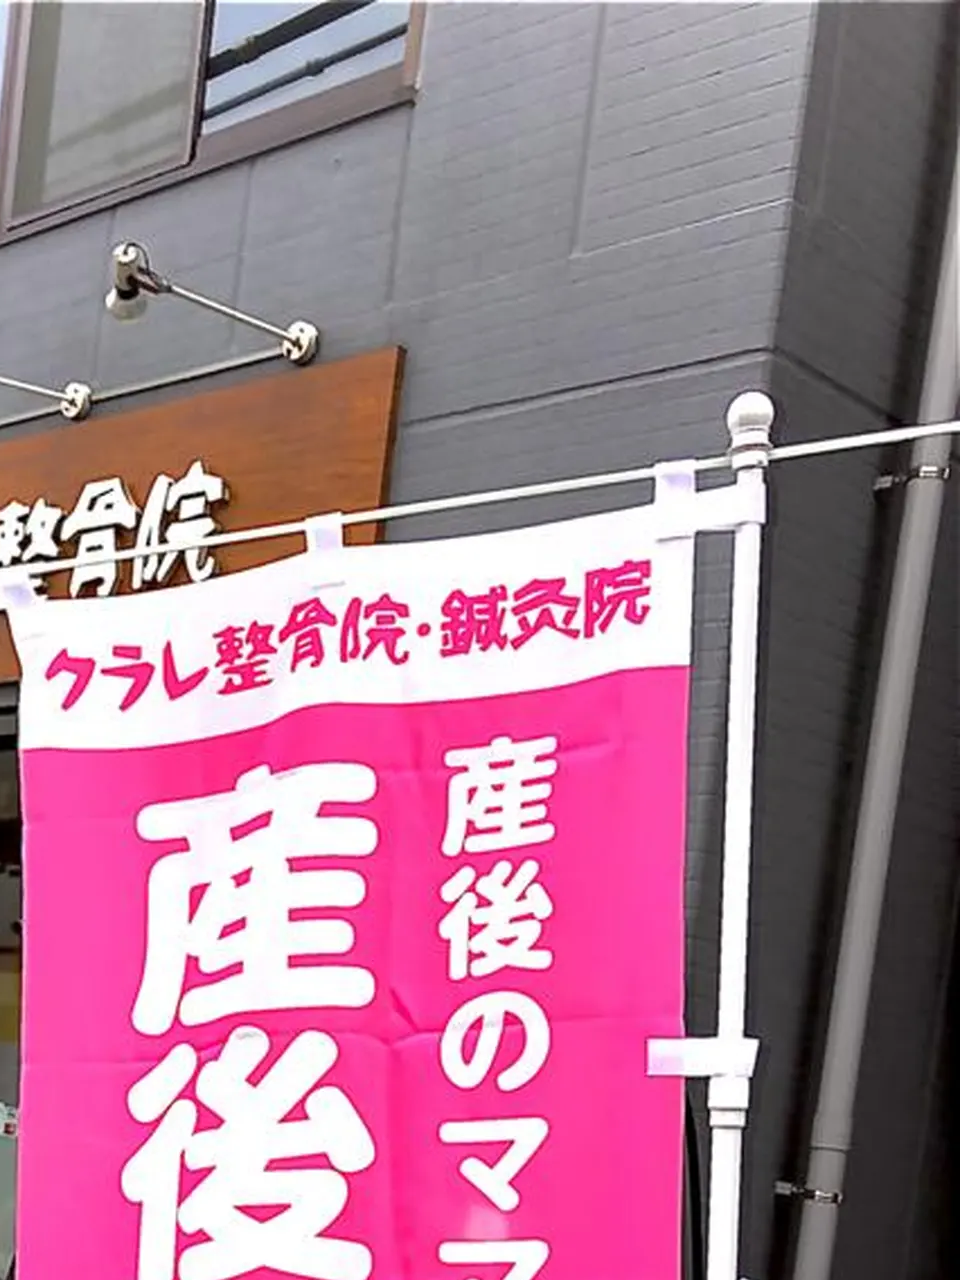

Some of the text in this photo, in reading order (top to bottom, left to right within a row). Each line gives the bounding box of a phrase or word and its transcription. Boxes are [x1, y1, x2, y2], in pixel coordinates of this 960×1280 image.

[44, 559, 653, 712] クラレ整骨院・鍼灸院
